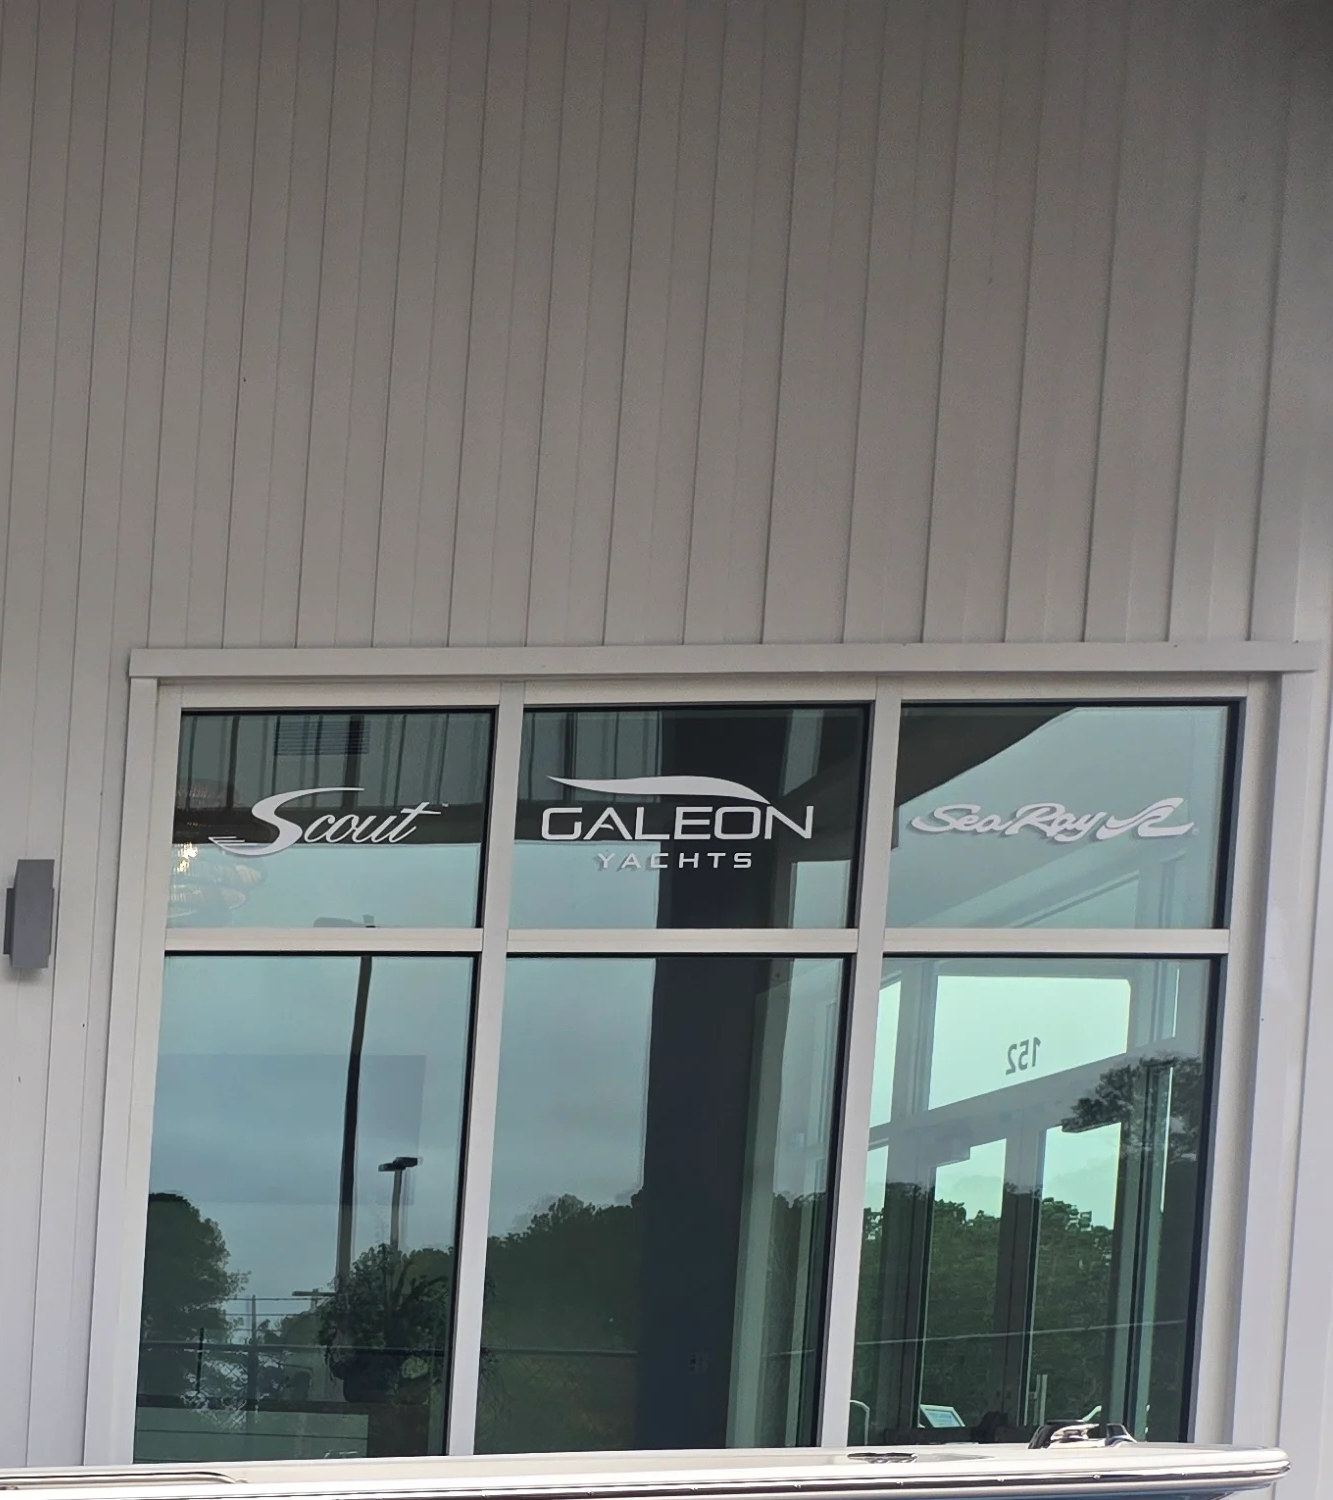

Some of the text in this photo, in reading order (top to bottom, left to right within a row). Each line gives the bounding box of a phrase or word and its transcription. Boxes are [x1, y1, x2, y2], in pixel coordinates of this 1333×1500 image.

[208, 786, 442, 857] Scout
[541, 805, 815, 841] GALEON
[597, 852, 753, 869] YACHTS
